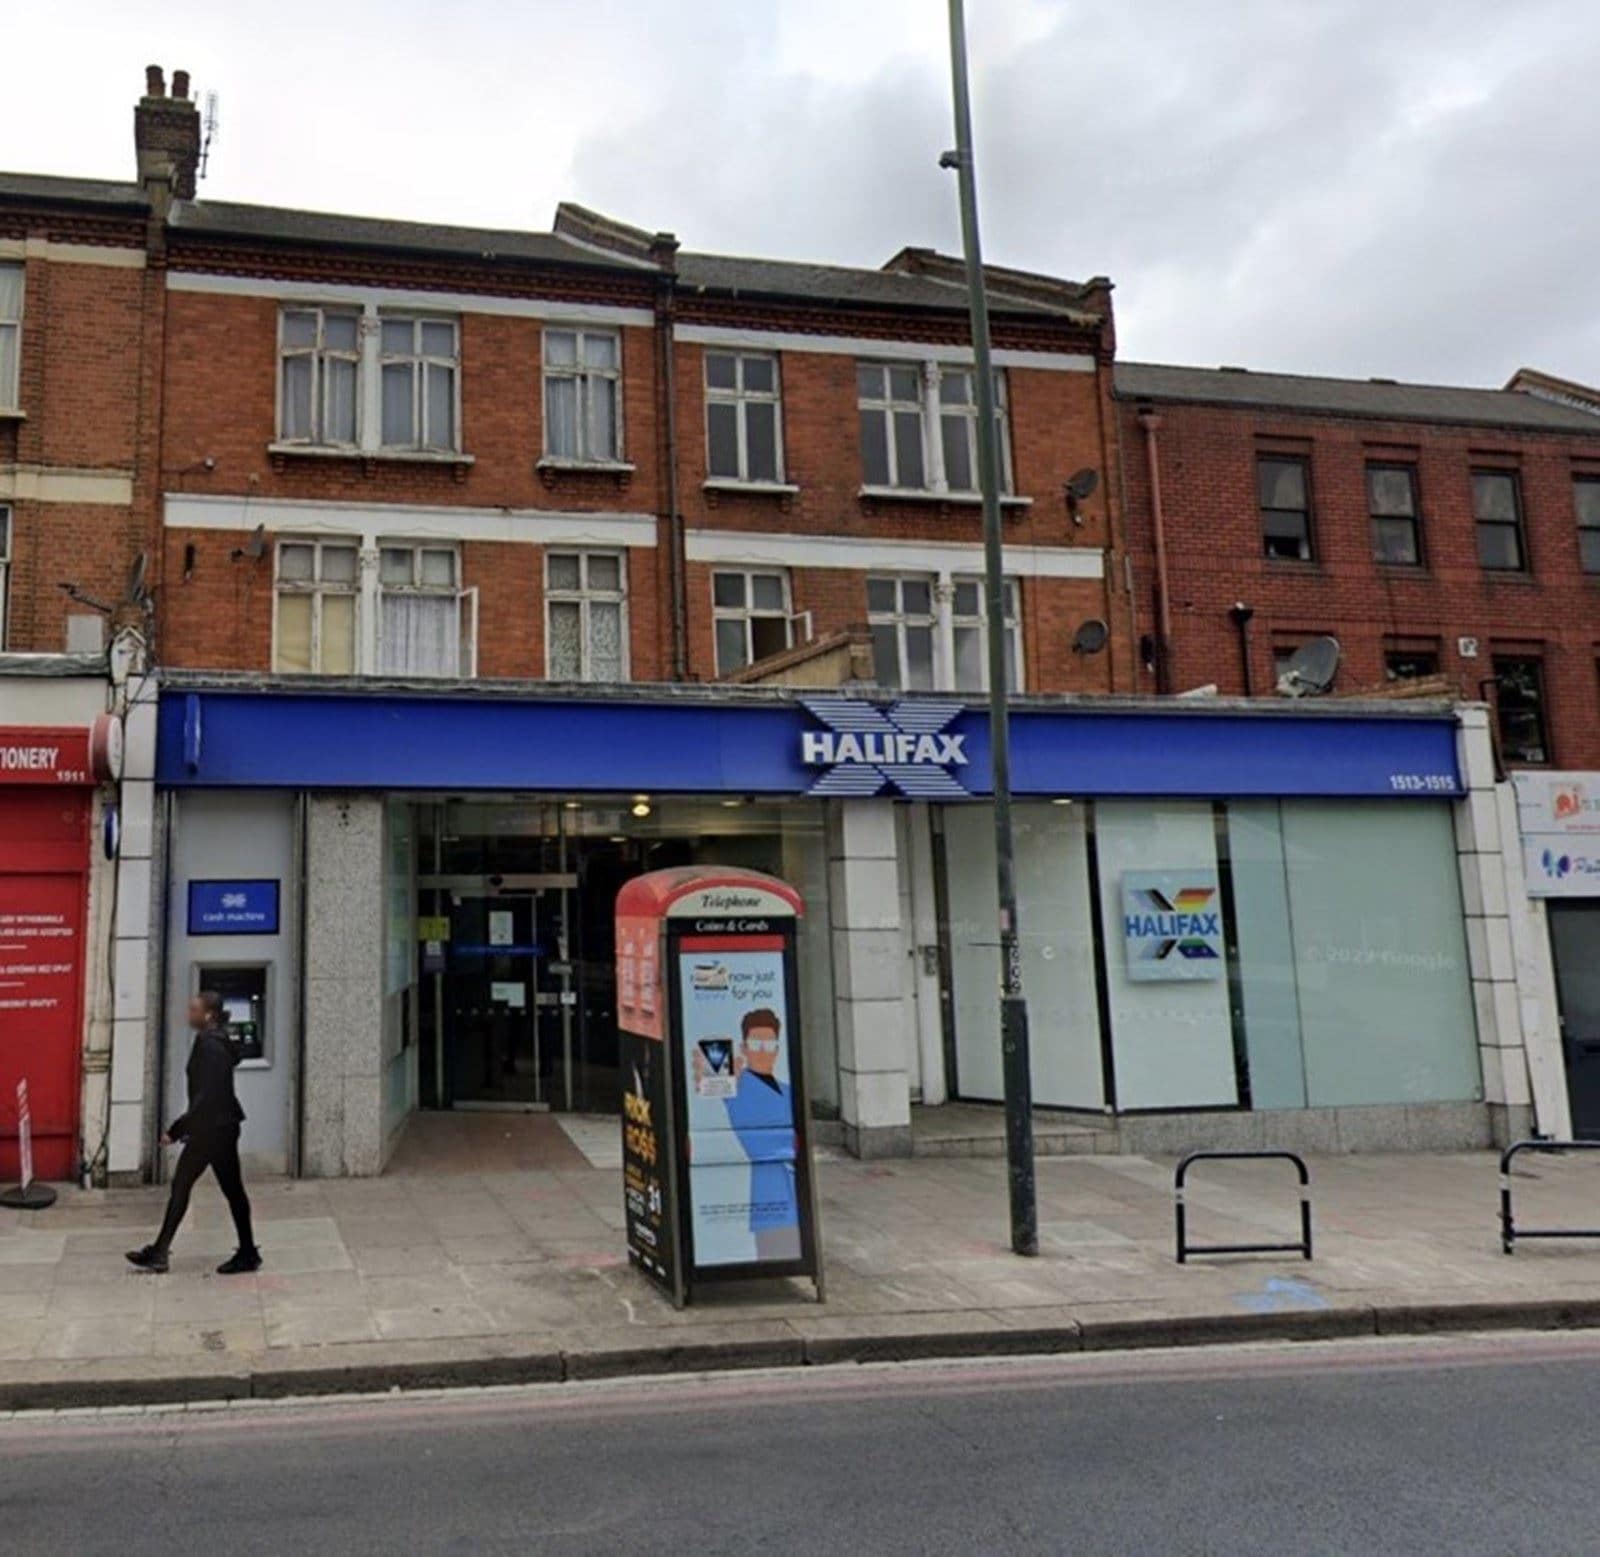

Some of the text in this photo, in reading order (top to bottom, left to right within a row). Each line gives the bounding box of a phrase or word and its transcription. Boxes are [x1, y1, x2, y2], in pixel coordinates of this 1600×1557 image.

[802, 732, 968, 764] HALIFAX
[1390, 775, 1456, 790] 1513-1515
[702, 894, 762, 910] Telephone
[202, 911, 266, 922] cash machine
[695, 919, 769, 932] Coins & Cards
[1124, 914, 1219, 936] HALIFAX
[729, 970, 775, 985] now just
[732, 985, 773, 1002] for you
